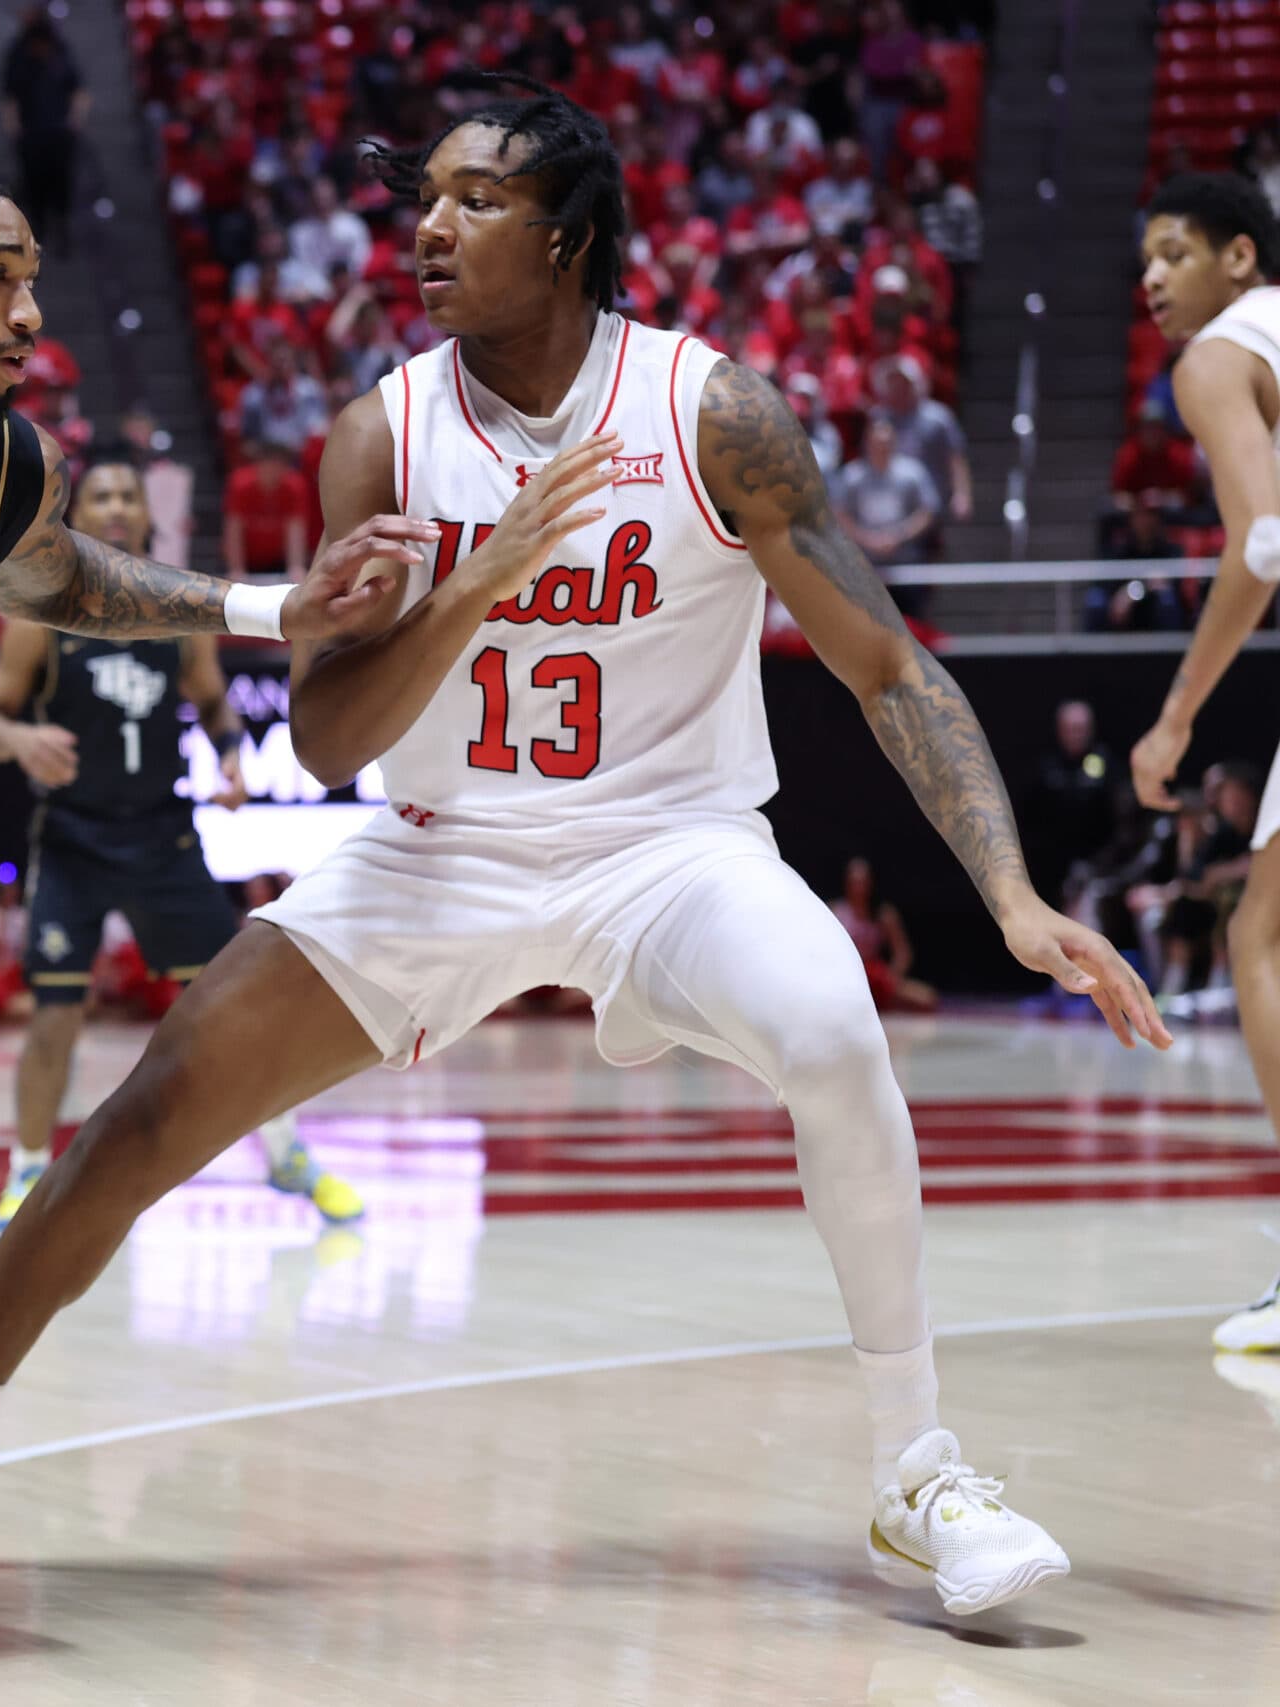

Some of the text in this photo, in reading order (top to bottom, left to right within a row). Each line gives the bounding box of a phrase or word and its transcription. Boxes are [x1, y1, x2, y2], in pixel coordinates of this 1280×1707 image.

[429, 517, 664, 626] Uah
[120, 721, 141, 773] 1
[468, 646, 602, 780] 13
